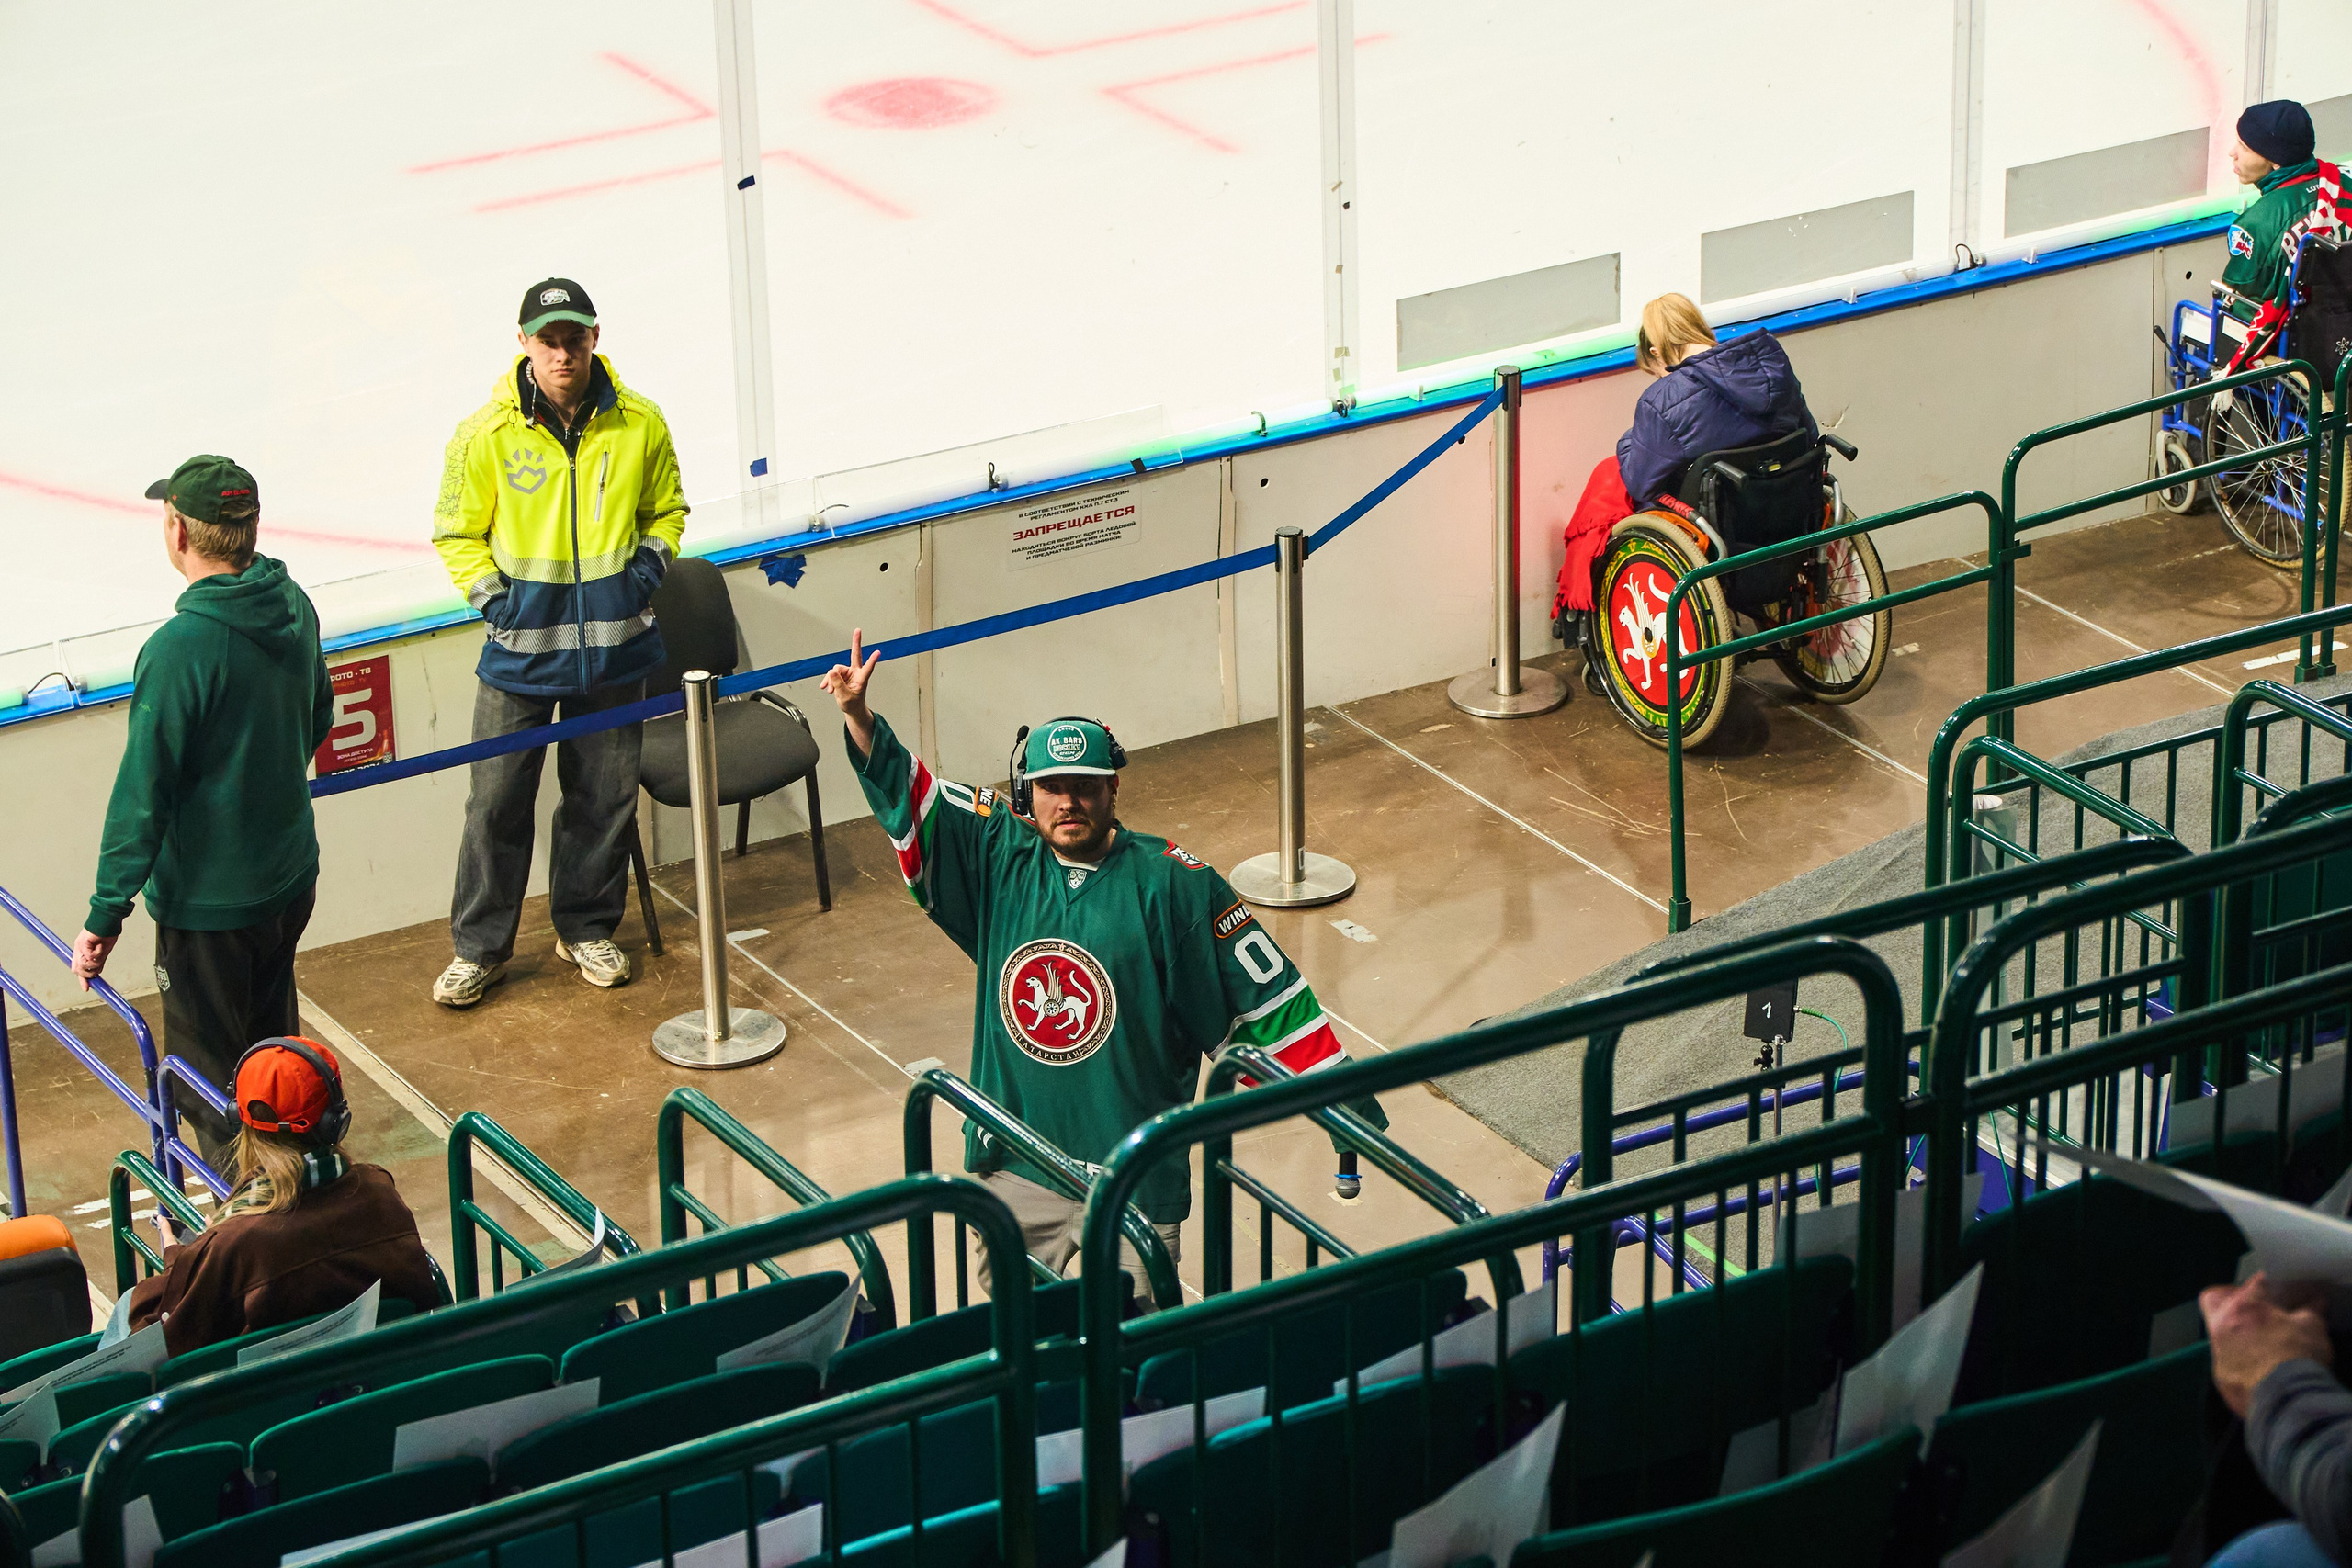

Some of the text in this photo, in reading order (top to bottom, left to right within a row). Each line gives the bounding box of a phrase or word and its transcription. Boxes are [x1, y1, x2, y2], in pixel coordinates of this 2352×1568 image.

[1024, 502, 1076, 517] СООТВЕТСТВИИ
[1083, 490, 1130, 504] ТЕХНИЧЕСКИМ
[1030, 506, 1079, 521] РЕГЛАМЕНТОМ
[1013, 505, 1136, 541] ЗАПРЕЩАЕТСЯ
[1012, 521, 1136, 554] НАХОДИТЬСЯ ВОКРУГ БОРТА ЛЕДОВОЙ
[1026, 543, 1065, 555] ПЛОЩАДКИ
[1075, 536, 1098, 545] ВРЕМЯ
[1099, 530, 1121, 539] МАТЧА
[1032, 543, 1084, 559] ПРЕДМАТЧЕВОЙ
[359, 667, 371, 675] ТВ
[332, 687, 377, 751] 5
[1051, 737, 1060, 746] AK
[1233, 930, 1284, 985] 0
[1761, 1001, 1772, 1019] 1
[1017, 1035, 1081, 1062] ТАТАРСТАН
